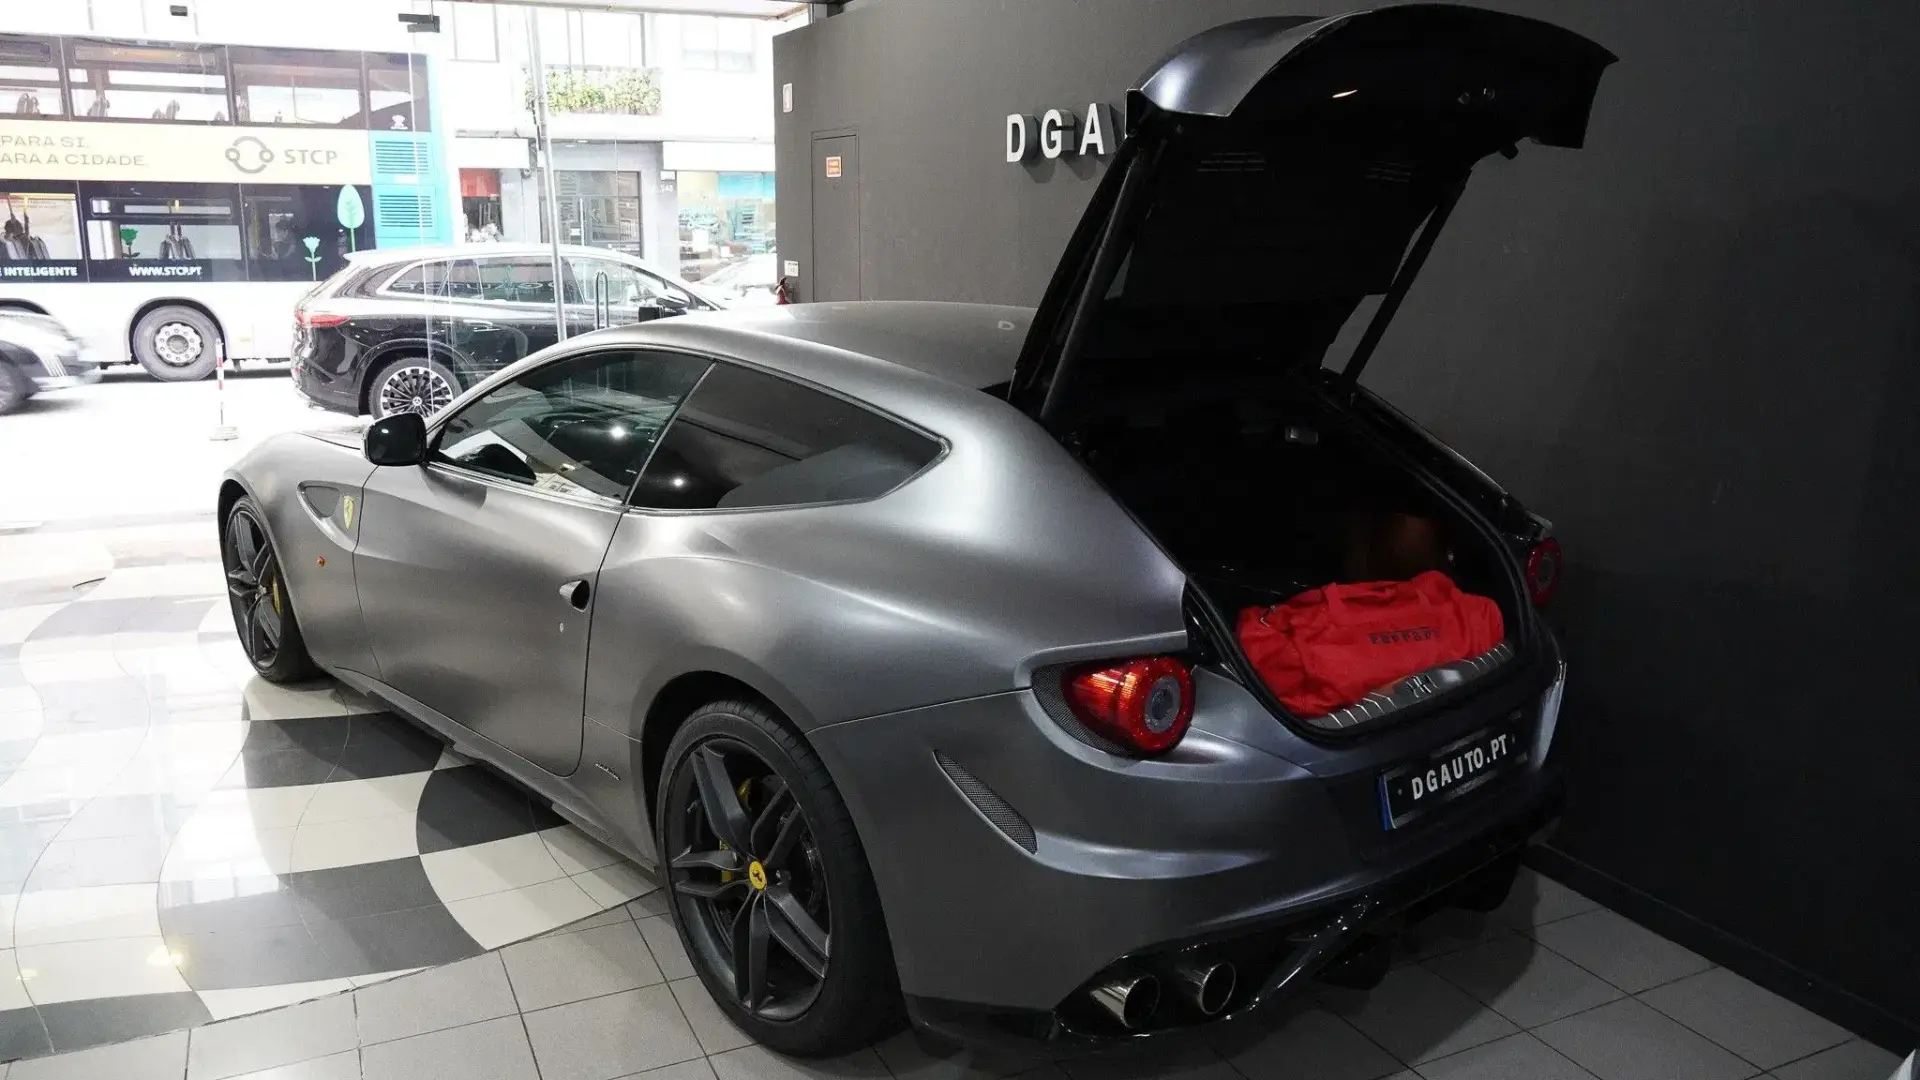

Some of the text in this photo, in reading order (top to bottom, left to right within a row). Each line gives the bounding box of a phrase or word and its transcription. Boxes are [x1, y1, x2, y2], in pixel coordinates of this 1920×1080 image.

[0, 135, 55, 148] PARA
[46, 153, 59, 165] A
[284, 149, 338, 165] STCP
[4, 266, 78, 277] INTELIGENTE
[1411, 733, 1507, 800] DGAUTO.PT
